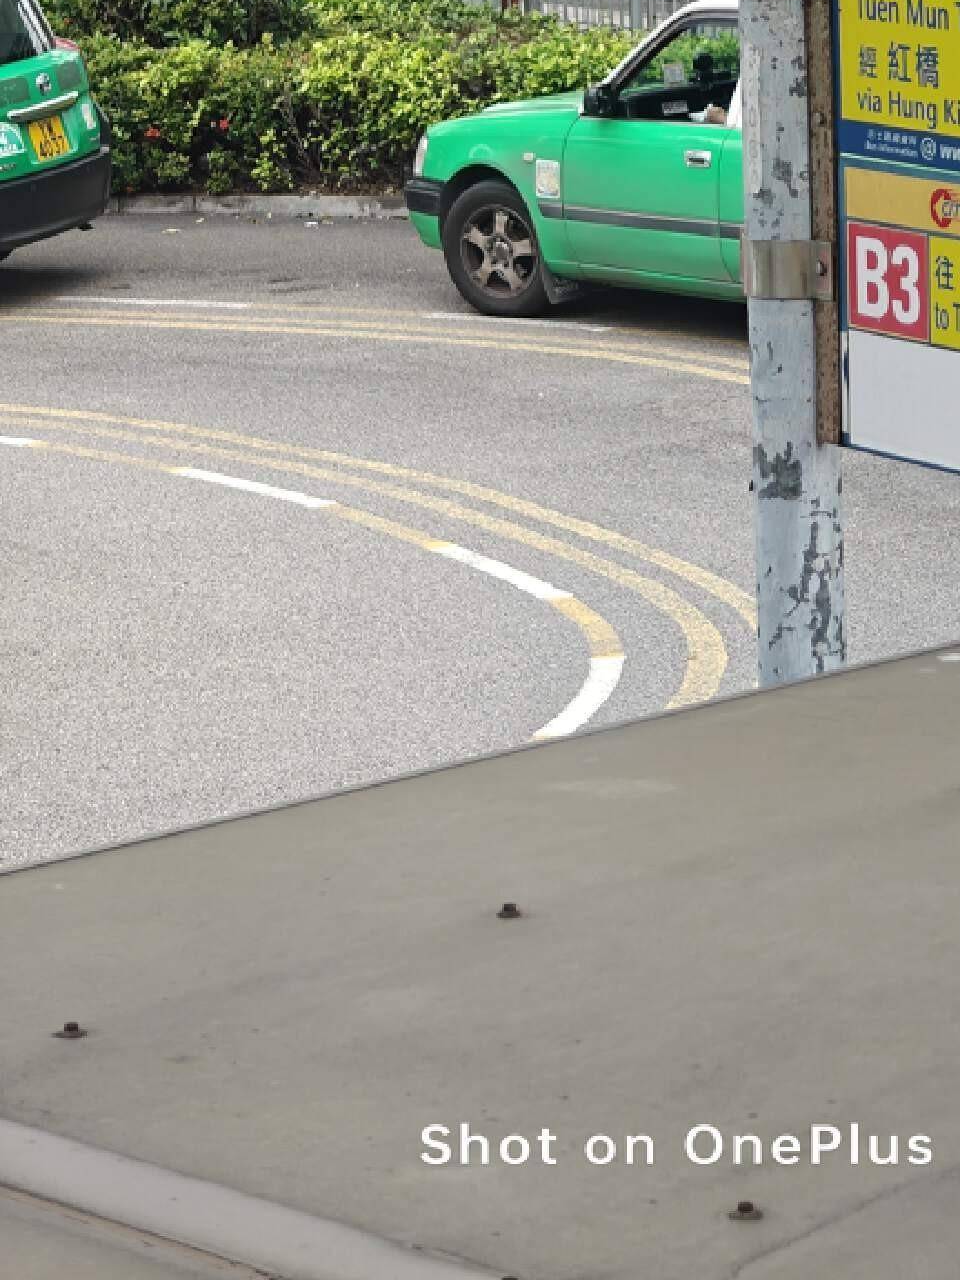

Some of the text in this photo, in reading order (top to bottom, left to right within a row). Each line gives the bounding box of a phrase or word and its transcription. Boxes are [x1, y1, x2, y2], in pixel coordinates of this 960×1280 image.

[857, 87, 882, 114] via
[888, 89, 938, 130] Hung
[855, 234, 921, 325] B3
[935, 255, 955, 290] 往
[935, 301, 950, 331] to
